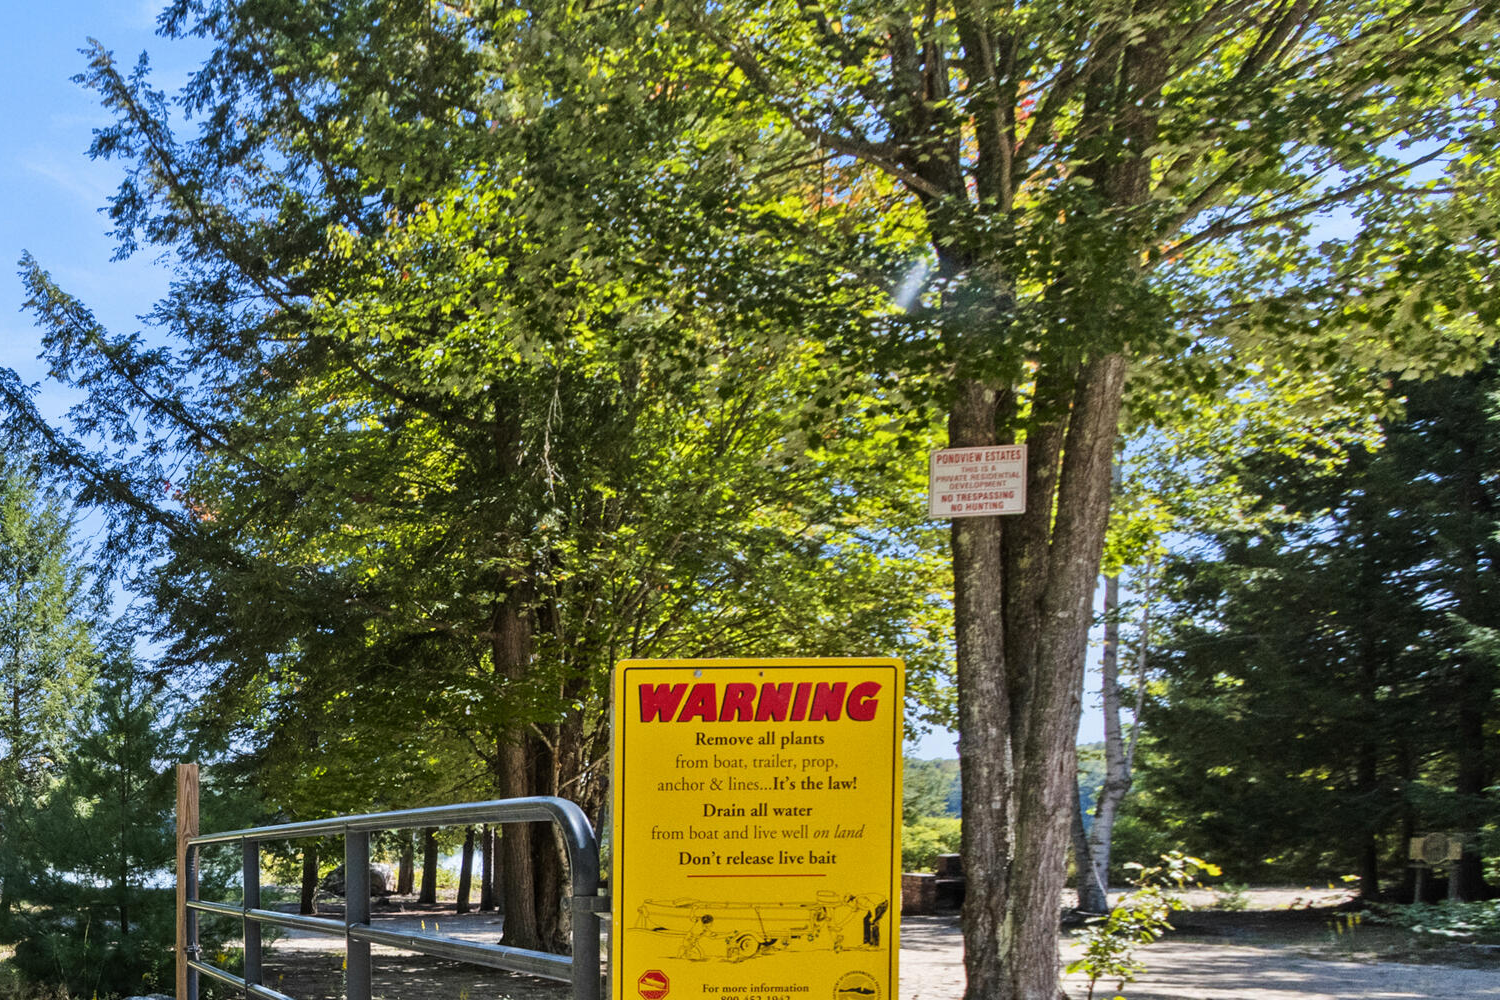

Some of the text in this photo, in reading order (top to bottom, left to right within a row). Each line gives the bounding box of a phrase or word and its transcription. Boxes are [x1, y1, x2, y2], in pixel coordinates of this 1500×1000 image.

[936, 450, 1021, 464] PONDVIEW ESTATES
[941, 491, 1015, 503] NO TRESPASSING
[951, 501, 1004, 512] NO HUNTING
[638, 681, 882, 723] WARNING
[695, 731, 825, 749] Remove all plants
[675, 754, 838, 772] from boat, trailer, prop,
[657, 777, 705, 791] anchor
[709, 777, 723, 791] &
[801, 776, 824, 790] the
[828, 776, 857, 790] law!
[703, 803, 813, 817] Drain all water
[651, 824, 866, 840] from boat and live well on land
[679, 851, 837, 865] Don't release live bait
[702, 983, 810, 993] For more information
